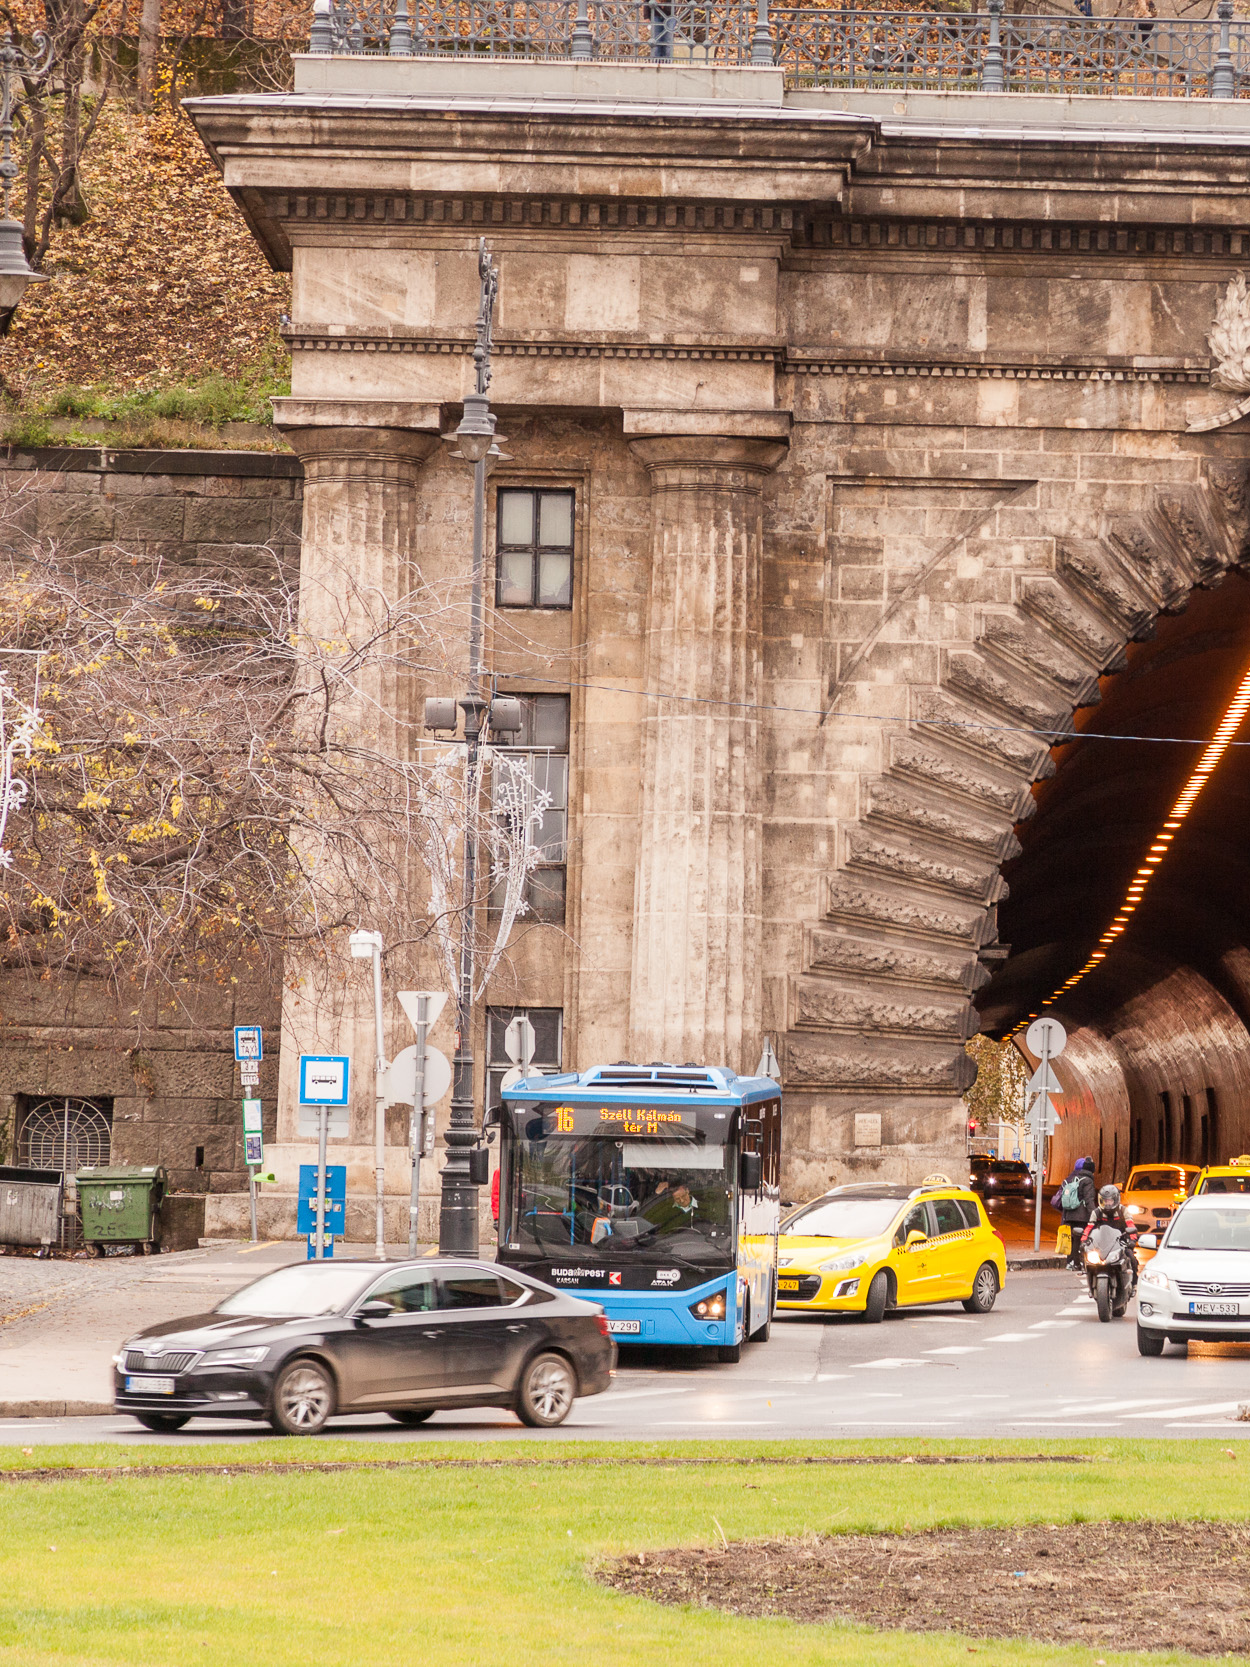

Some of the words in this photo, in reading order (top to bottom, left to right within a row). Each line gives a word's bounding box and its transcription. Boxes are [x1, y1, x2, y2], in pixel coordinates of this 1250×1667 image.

[241, 1045, 257, 1054] TAXI
[555, 1107, 574, 1132] 16
[600, 1108, 632, 1121] Széll
[637, 1109, 682, 1122] Kálmán
[623, 1122, 642, 1133] tér
[647, 1122, 658, 1133] M
[1196, 1303, 1236, 1313] MEV-533
